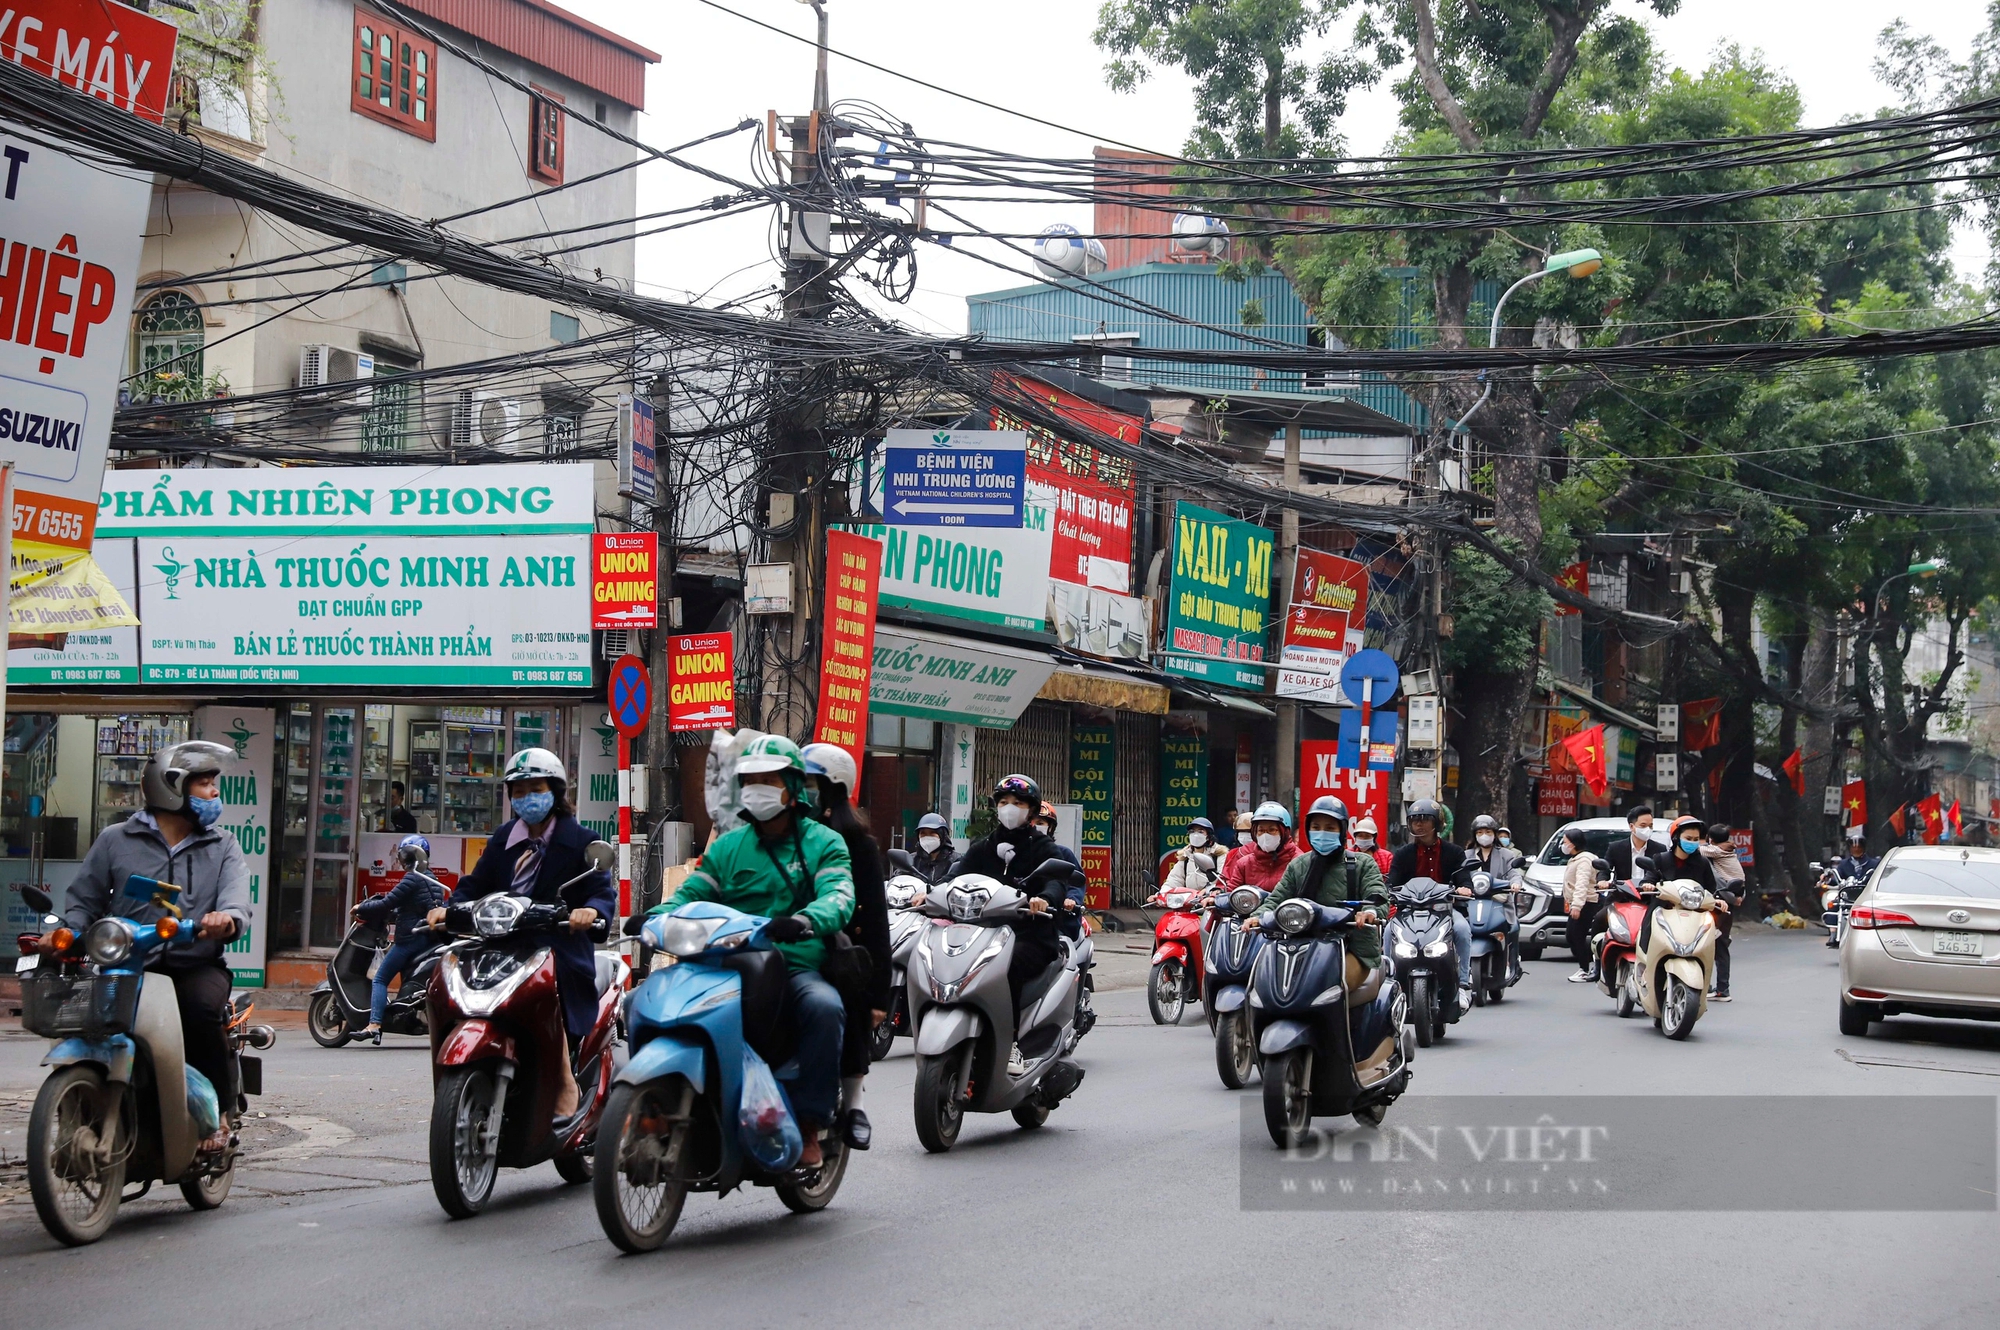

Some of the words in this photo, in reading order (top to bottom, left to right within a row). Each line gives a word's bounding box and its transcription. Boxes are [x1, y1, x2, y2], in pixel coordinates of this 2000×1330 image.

[52, 31, 151, 113] MÁY
[0, 233, 116, 352] HIỆP
[0, 407, 80, 451] SUZUKI
[917, 451, 956, 472] BỆNH
[960, 453, 994, 472] VIỆN
[893, 473, 918, 487] NHI
[923, 474, 971, 488] TRUNG
[975, 473, 1016, 489] ƯƠNG
[97, 474, 213, 517] PHẨM
[228, 481, 374, 517] NHIÊN
[389, 486, 554, 516] PHONG
[895, 490, 920, 498] VIETNAM
[921, 490, 949, 498] NATIONAL
[1061, 485, 1077, 517] ĐẶT
[1078, 491, 1097, 520] THEO
[940, 516, 965, 524] 100M
[1023, 489, 1048, 532] ẨM
[38, 508, 83, 541] 6555
[194, 549, 266, 588] NHÀ
[275, 543, 389, 588] THUỐC
[400, 557, 489, 587] MINH
[499, 556, 576, 587] ANH
[600, 552, 650, 573] UNION
[913, 533, 1004, 598] PHONG
[1177, 514, 1231, 589] NAIL
[1245, 536, 1272, 599] MI
[594, 580, 655, 602] GAMING
[1315, 575, 1357, 611] Havoline
[298, 600, 327, 620] ĐẠT
[332, 593, 386, 617] CHUẨN
[391, 600, 422, 616] GPP
[1180, 590, 1195, 621] GỘI
[1195, 591, 1214, 624] ĐẦU
[1214, 600, 1240, 629] TRUNG
[1240, 603, 1263, 634] QUỐC
[233, 630, 271, 656] BÁN
[276, 628, 298, 656] LẺ
[302, 627, 364, 656] THUỐC
[369, 630, 434, 657] THÀNH
[439, 624, 492, 657] PHẨM
[1173, 627, 1206, 655] MASSAGE
[1205, 634, 1223, 657] BODY
[1293, 624, 1337, 640] Havoline
[675, 652, 725, 676] UNION
[872, 643, 923, 672] HUỐC
[919, 655, 976, 681] MINH
[970, 664, 1017, 688] ANH
[1284, 652, 1304, 663] HOÀNG
[1305, 655, 1318, 664] ANH
[1319, 657, 1341, 667] MOTOR
[65, 670, 86, 679] 0983
[87, 670, 103, 679] 687
[165, 668, 180, 679] 879
[200, 669, 210, 678] LA
[211, 667, 238, 679] THÀNH
[527, 671, 548, 681] 0983
[549, 671, 565, 681] 687
[567, 671, 583, 681] 856
[1283, 673, 1293, 684] XE
[671, 680, 732, 705] GAMING
[1080, 750, 1100, 761] MI
[1165, 743, 1204, 753] NAIL
[1073, 767, 1104, 783] GỘI
[1175, 760, 1193, 769] MI
[1315, 753, 1341, 789] XE
[219, 770, 257, 805] NHÀ
[1070, 786, 1107, 801] ĐẦU
[1169, 776, 1199, 791] GỘI
[1166, 793, 1202, 807] ĐẦU
[1083, 811, 1110, 821] UNG
[1081, 860, 1102, 870] ODY
[1938, 941, 1977, 953] 546.37
